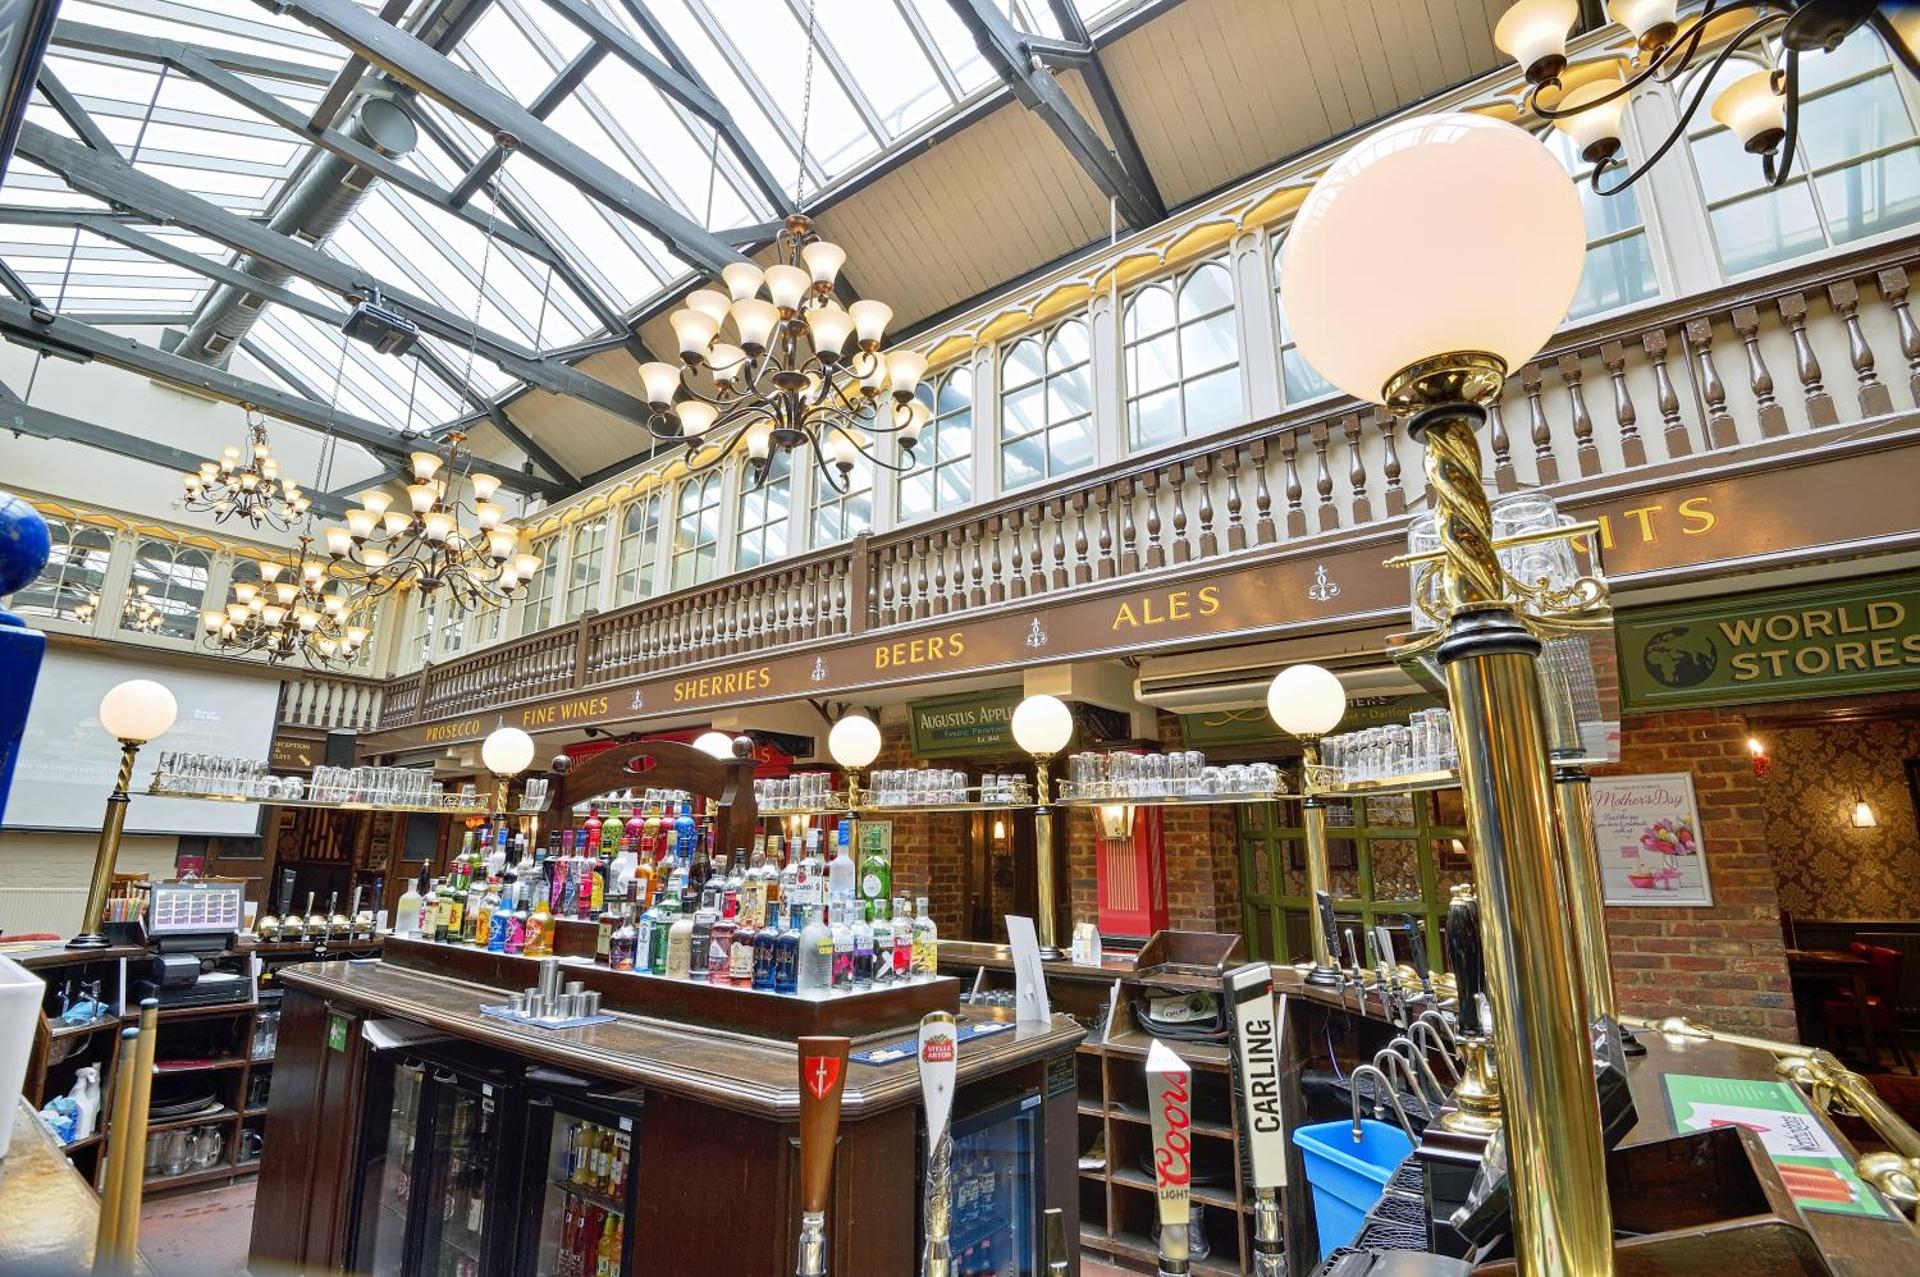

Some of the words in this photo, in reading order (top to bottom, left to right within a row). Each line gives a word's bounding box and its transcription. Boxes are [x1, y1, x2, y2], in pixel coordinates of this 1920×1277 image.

[1111, 584, 1221, 631] ALES
[1719, 601, 1906, 646] WORLD
[874, 632, 965, 669] BEERS
[1730, 634, 1920, 681] STORES
[673, 666, 771, 703] SHERRIES
[522, 705, 555, 727] FINE
[560, 696, 608, 720] WINES
[920, 710, 976, 730] AUGUSTUS
[425, 719, 481, 742] PROSECCO
[1594, 789, 1653, 808] Mother's
[1653, 789, 1683, 808] Day
[927, 1044, 951, 1052] STELLA
[927, 1051, 952, 1059] ARTOIS
[1244, 1019, 1282, 1134] CARLING
[1155, 1071, 1191, 1188] Coors
[1160, 1189, 1190, 1200] LIGHT
